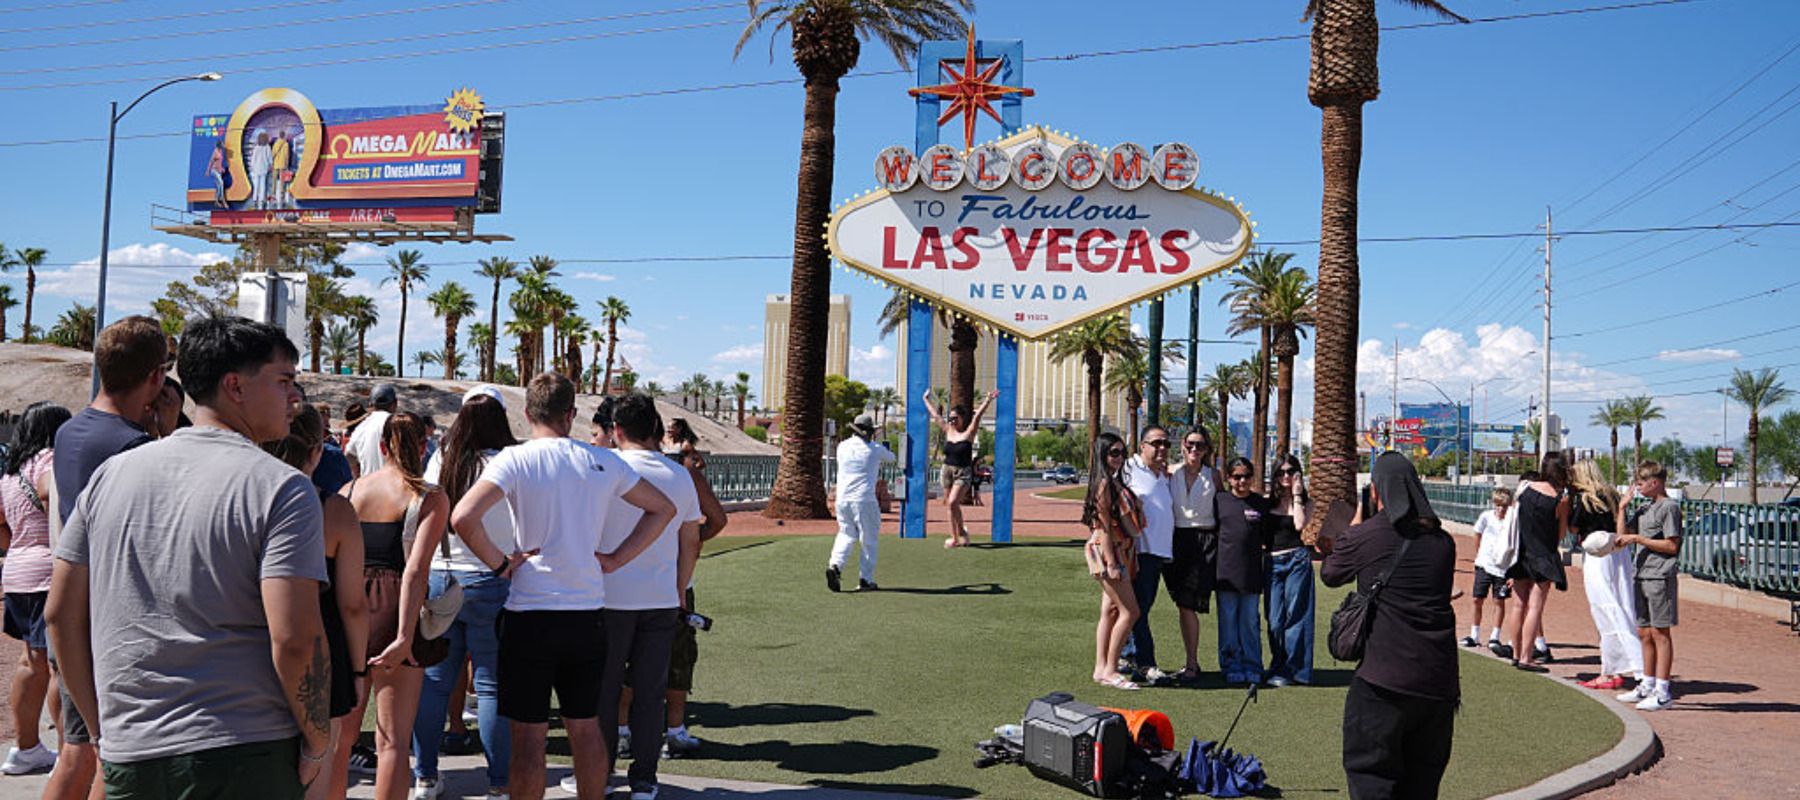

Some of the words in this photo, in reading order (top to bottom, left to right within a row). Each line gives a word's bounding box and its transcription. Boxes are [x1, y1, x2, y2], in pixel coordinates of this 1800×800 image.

[337, 167, 371, 180] TICKETS
[371, 166, 383, 179] AT
[881, 152, 1188, 185] WELCOME
[913, 199, 946, 218] TO
[957, 194, 1151, 224] Fabulous
[881, 225, 982, 271] LAS
[1000, 226, 1192, 275] VEGAS
[968, 282, 1089, 301] NEVADA
